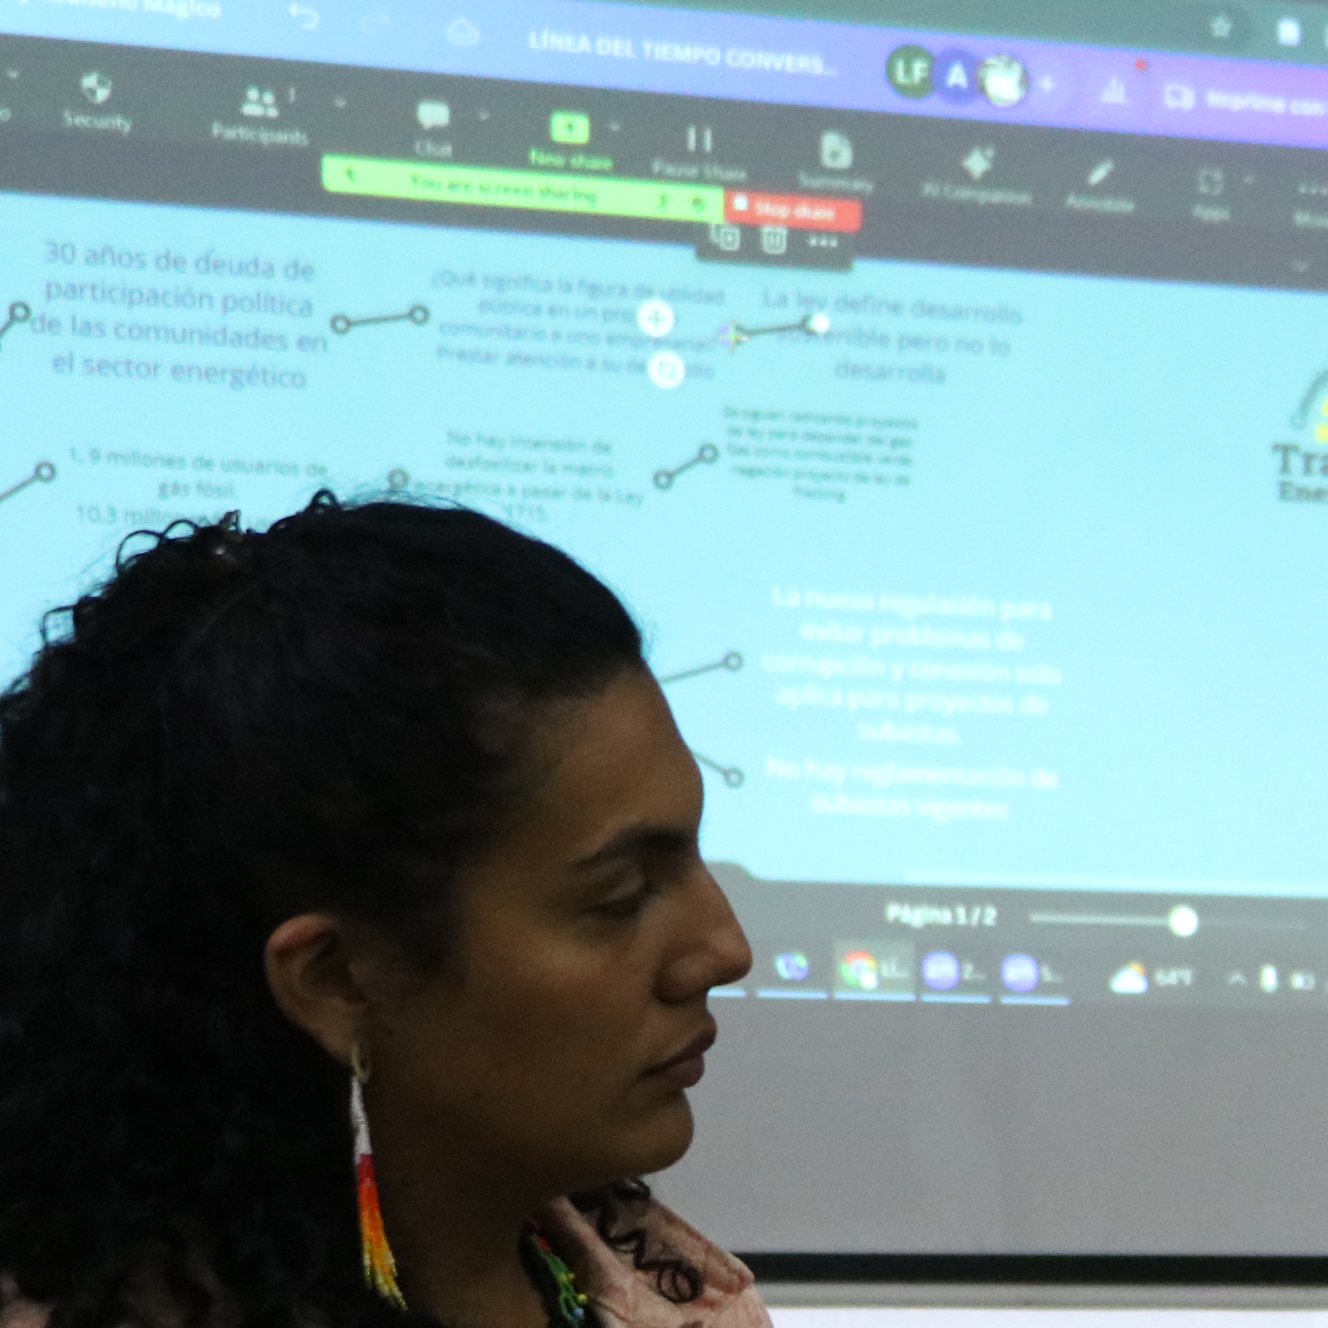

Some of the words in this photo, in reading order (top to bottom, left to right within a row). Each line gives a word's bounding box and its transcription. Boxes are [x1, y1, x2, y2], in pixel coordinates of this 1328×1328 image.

[528, 28, 591, 55] LÍNEA
[596, 37, 636, 60] DEL
[642, 40, 720, 66] TIEMPO
[895, 59, 928, 84] LF
[946, 62, 968, 88] A
[1207, 90, 1286, 114] Imprime
[1290, 98, 1324, 116] con
[62, 109, 132, 135] Security
[210, 121, 309, 147] Participants
[414, 139, 454, 158] Chat
[528, 147, 566, 166] New
[571, 151, 614, 171] share
[411, 174, 442, 192] You
[448, 179, 473, 194] are
[478, 180, 534, 200] screen
[539, 182, 598, 208] sharing
[45, 240, 76, 264] 30
[84, 244, 146, 268] años
[154, 250, 186, 273] de
[194, 252, 274, 278] deuda
[284, 259, 314, 281] de
[430, 268, 476, 290] ¿Qué
[482, 272, 552, 294] significa
[558, 276, 572, 293] la
[578, 278, 628, 300] figura
[633, 282, 654, 298] de
[46, 280, 213, 310] participación
[221, 292, 313, 318] política
[547, 302, 570, 316] en
[574, 304, 597, 318] un
[763, 286, 788, 309] La
[835, 292, 904, 318] define
[911, 296, 1024, 326] desarrollo
[30, 313, 60, 336] de
[71, 315, 106, 339] las
[114, 320, 288, 351] comunidades
[296, 335, 328, 353] en
[438, 321, 546, 343] comunitario
[552, 330, 561, 343] a
[436, 346, 500, 365] Prestar
[506, 350, 582, 370] atención
[586, 358, 596, 371] a
[602, 358, 622, 373] su
[898, 335, 949, 354] pero
[955, 337, 984, 354] no
[991, 335, 1011, 358] lo
[52, 352, 74, 374] el
[82, 355, 162, 379] sector
[171, 360, 306, 390] energético
[834, 358, 946, 386] desarrolla
[448, 430, 472, 446] No
[476, 432, 506, 451] hay
[592, 439, 612, 454] de
[107, 449, 186, 470] millones
[192, 454, 215, 472] de
[220, 457, 298, 477] usuarios
[305, 460, 328, 476] de
[771, 584, 800, 608] La
[805, 589, 874, 612] nueva
[879, 592, 996, 620] regulación
[1001, 600, 1052, 623] para
[800, 622, 864, 644] evitar
[870, 624, 991, 650] problemas
[996, 628, 1026, 651] de
[761, 654, 886, 680] corrupción
[890, 661, 905, 684] y
[908, 660, 1011, 682] conexión
[1016, 663, 1063, 686] solo
[775, 684, 843, 710] aplica
[848, 690, 900, 713] para
[904, 692, 1014, 717] proyectos
[1020, 693, 1050, 716] de
[764, 755, 800, 779] No
[805, 757, 846, 786] hay
[852, 762, 1026, 788] reglamentación
[1030, 767, 1060, 790] de
[810, 792, 912, 816] subastas
[915, 798, 1010, 824] vigentes
[885, 901, 952, 929] Página
[956, 904, 968, 926] 1
[984, 905, 996, 926] 2
